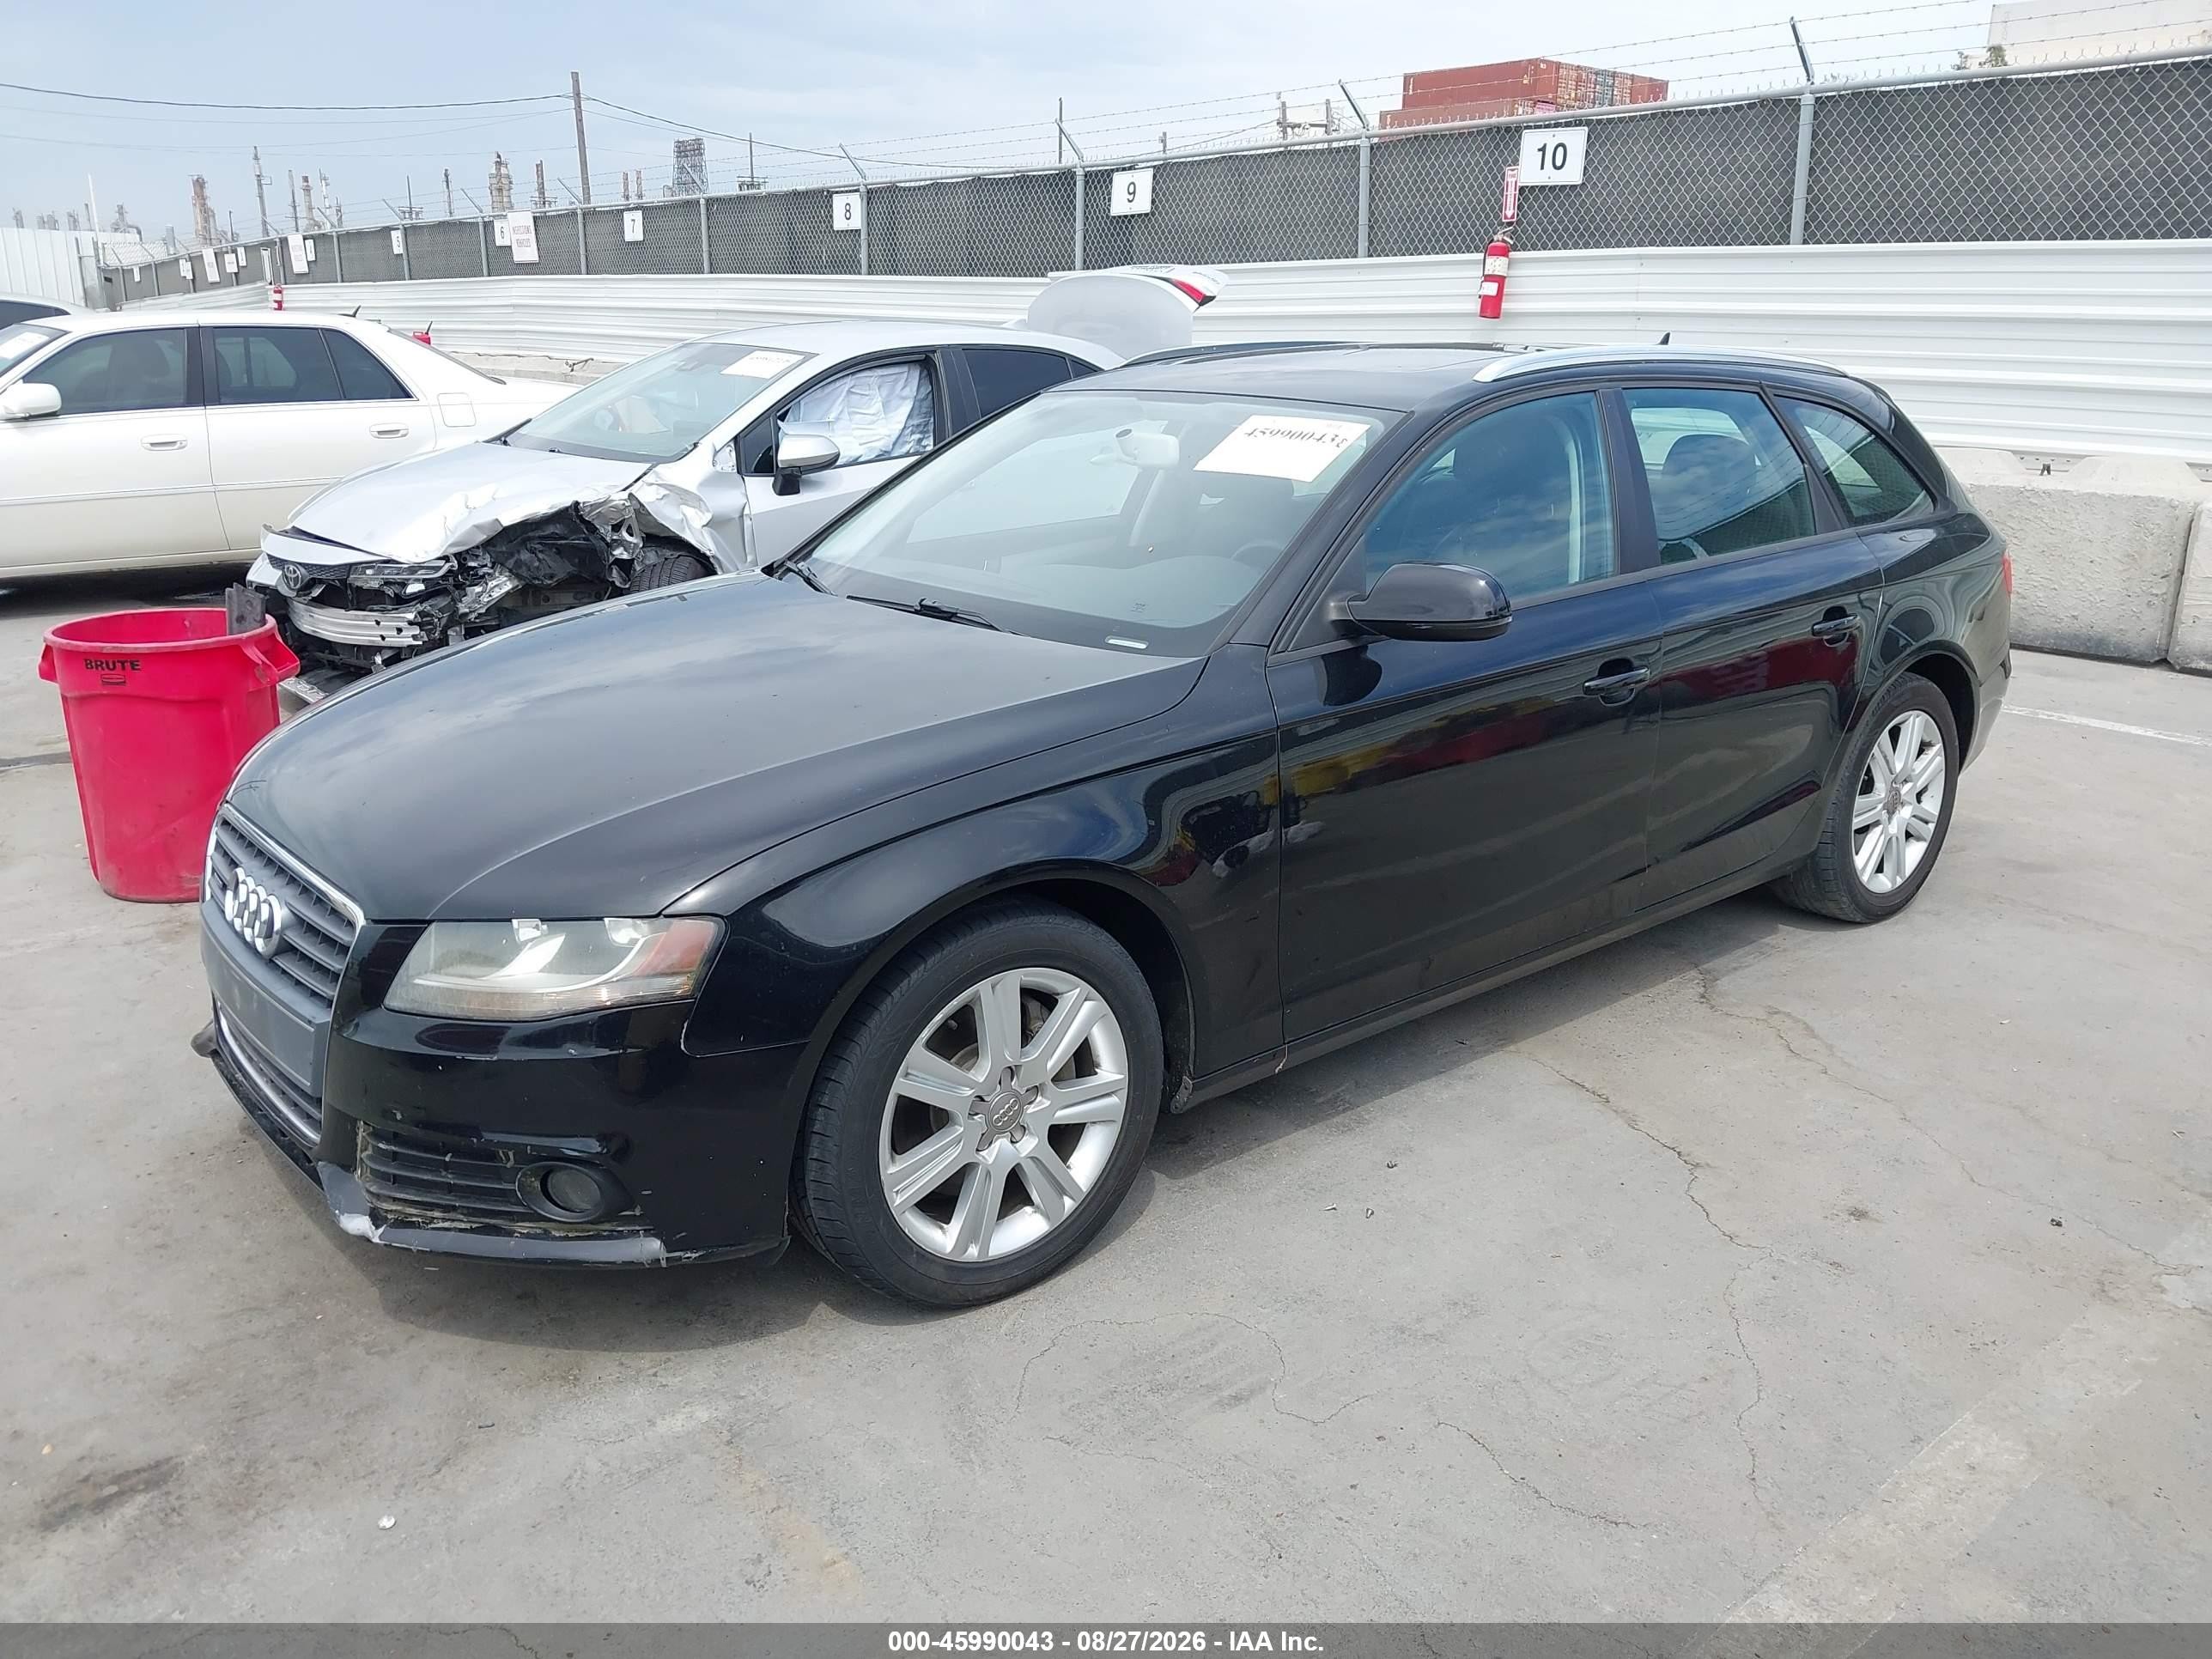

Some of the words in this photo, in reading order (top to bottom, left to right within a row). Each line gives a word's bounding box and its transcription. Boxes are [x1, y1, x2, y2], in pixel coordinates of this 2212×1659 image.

[1537, 143, 1567, 171] 10
[1127, 181, 1136, 204] 9
[844, 203, 852, 221] 8
[500, 226, 505, 240] 6
[630, 218, 636, 234] 7
[396, 235, 401, 248] 5
[84, 659, 141, 672] BRUTE
